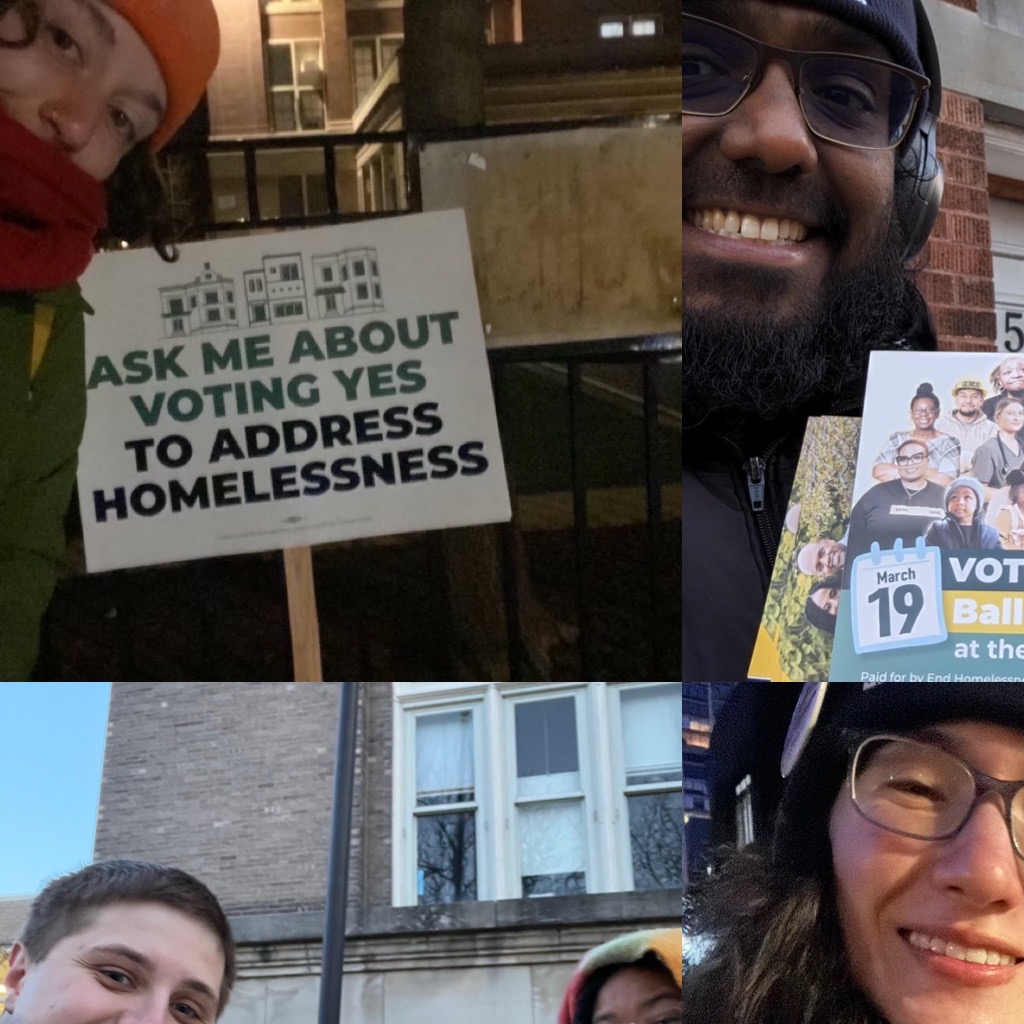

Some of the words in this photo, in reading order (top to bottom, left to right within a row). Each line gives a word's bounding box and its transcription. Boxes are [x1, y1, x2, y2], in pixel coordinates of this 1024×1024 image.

[88, 346, 188, 389] ASK
[203, 334, 274, 375] ME
[289, 311, 459, 364] ABOUT
[130, 374, 320, 426] VOTING
[332, 360, 426, 400] YES
[125, 434, 192, 472] TO
[209, 402, 444, 463] ADDRESS
[93, 441, 488, 522] HOMELESSNESS
[876, 568, 916, 585] March
[868, 584, 924, 638] 19
[954, 640, 979, 658] at
